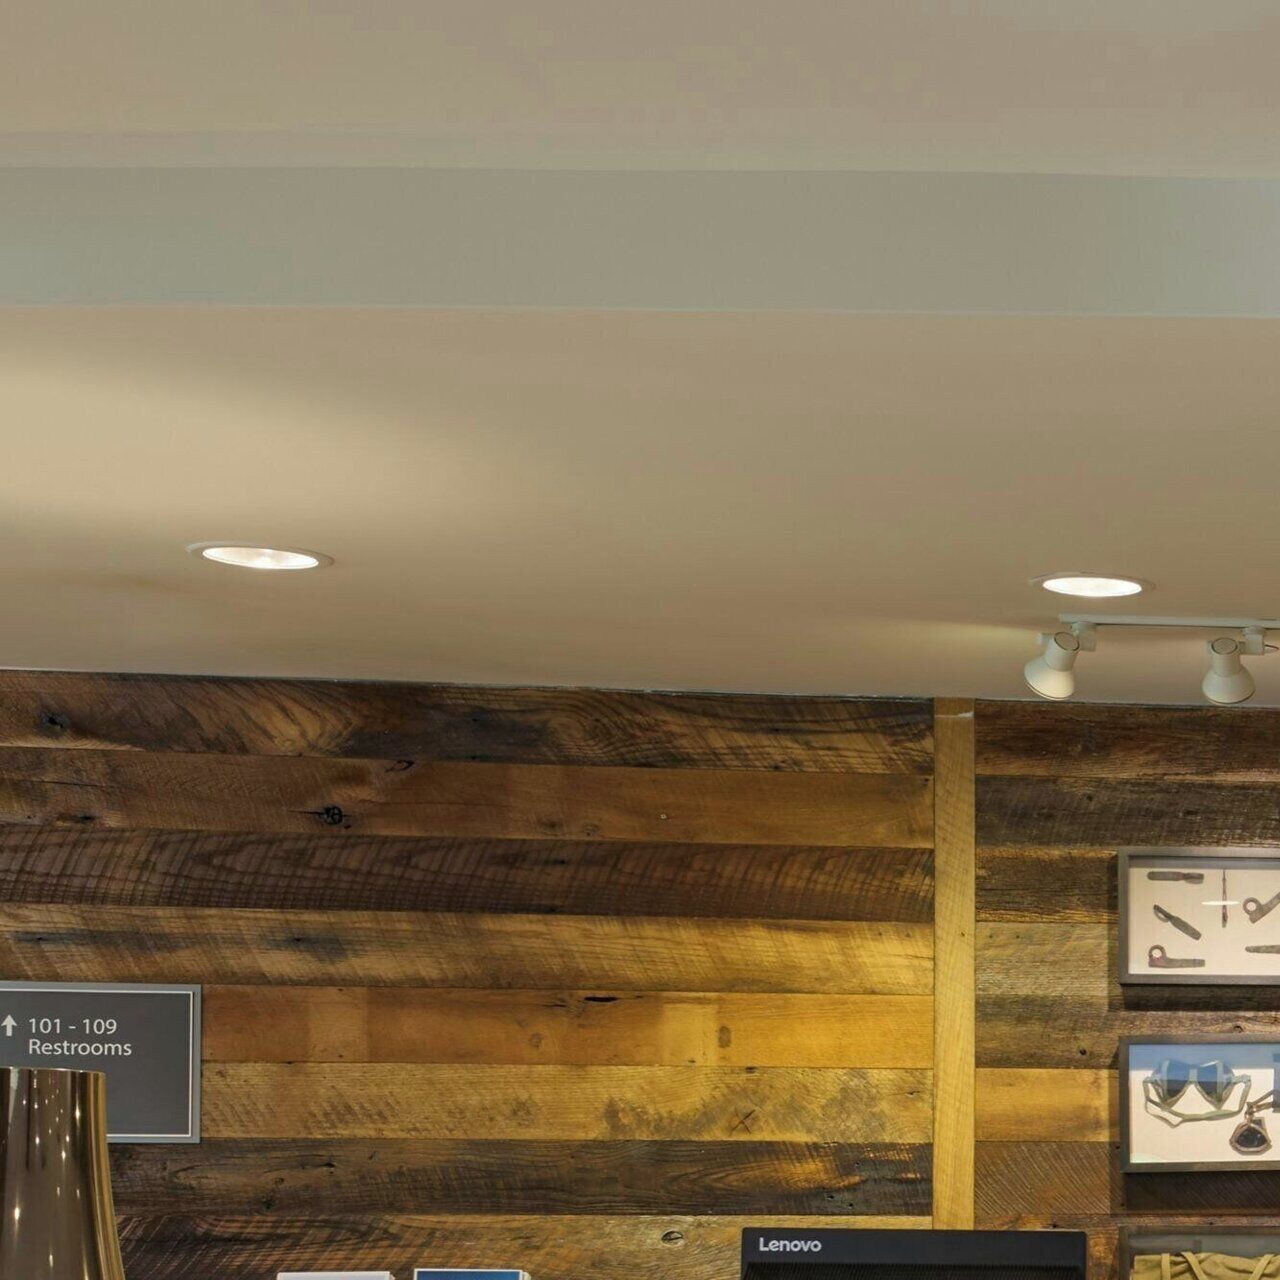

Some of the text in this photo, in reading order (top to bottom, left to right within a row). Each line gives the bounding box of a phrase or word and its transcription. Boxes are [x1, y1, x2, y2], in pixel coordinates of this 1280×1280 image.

[28, 1018, 61, 1034] 101
[82, 1018, 118, 1035] 109
[28, 1038, 132, 1056] Restrooms
[759, 1236, 822, 1252] Lenovo
